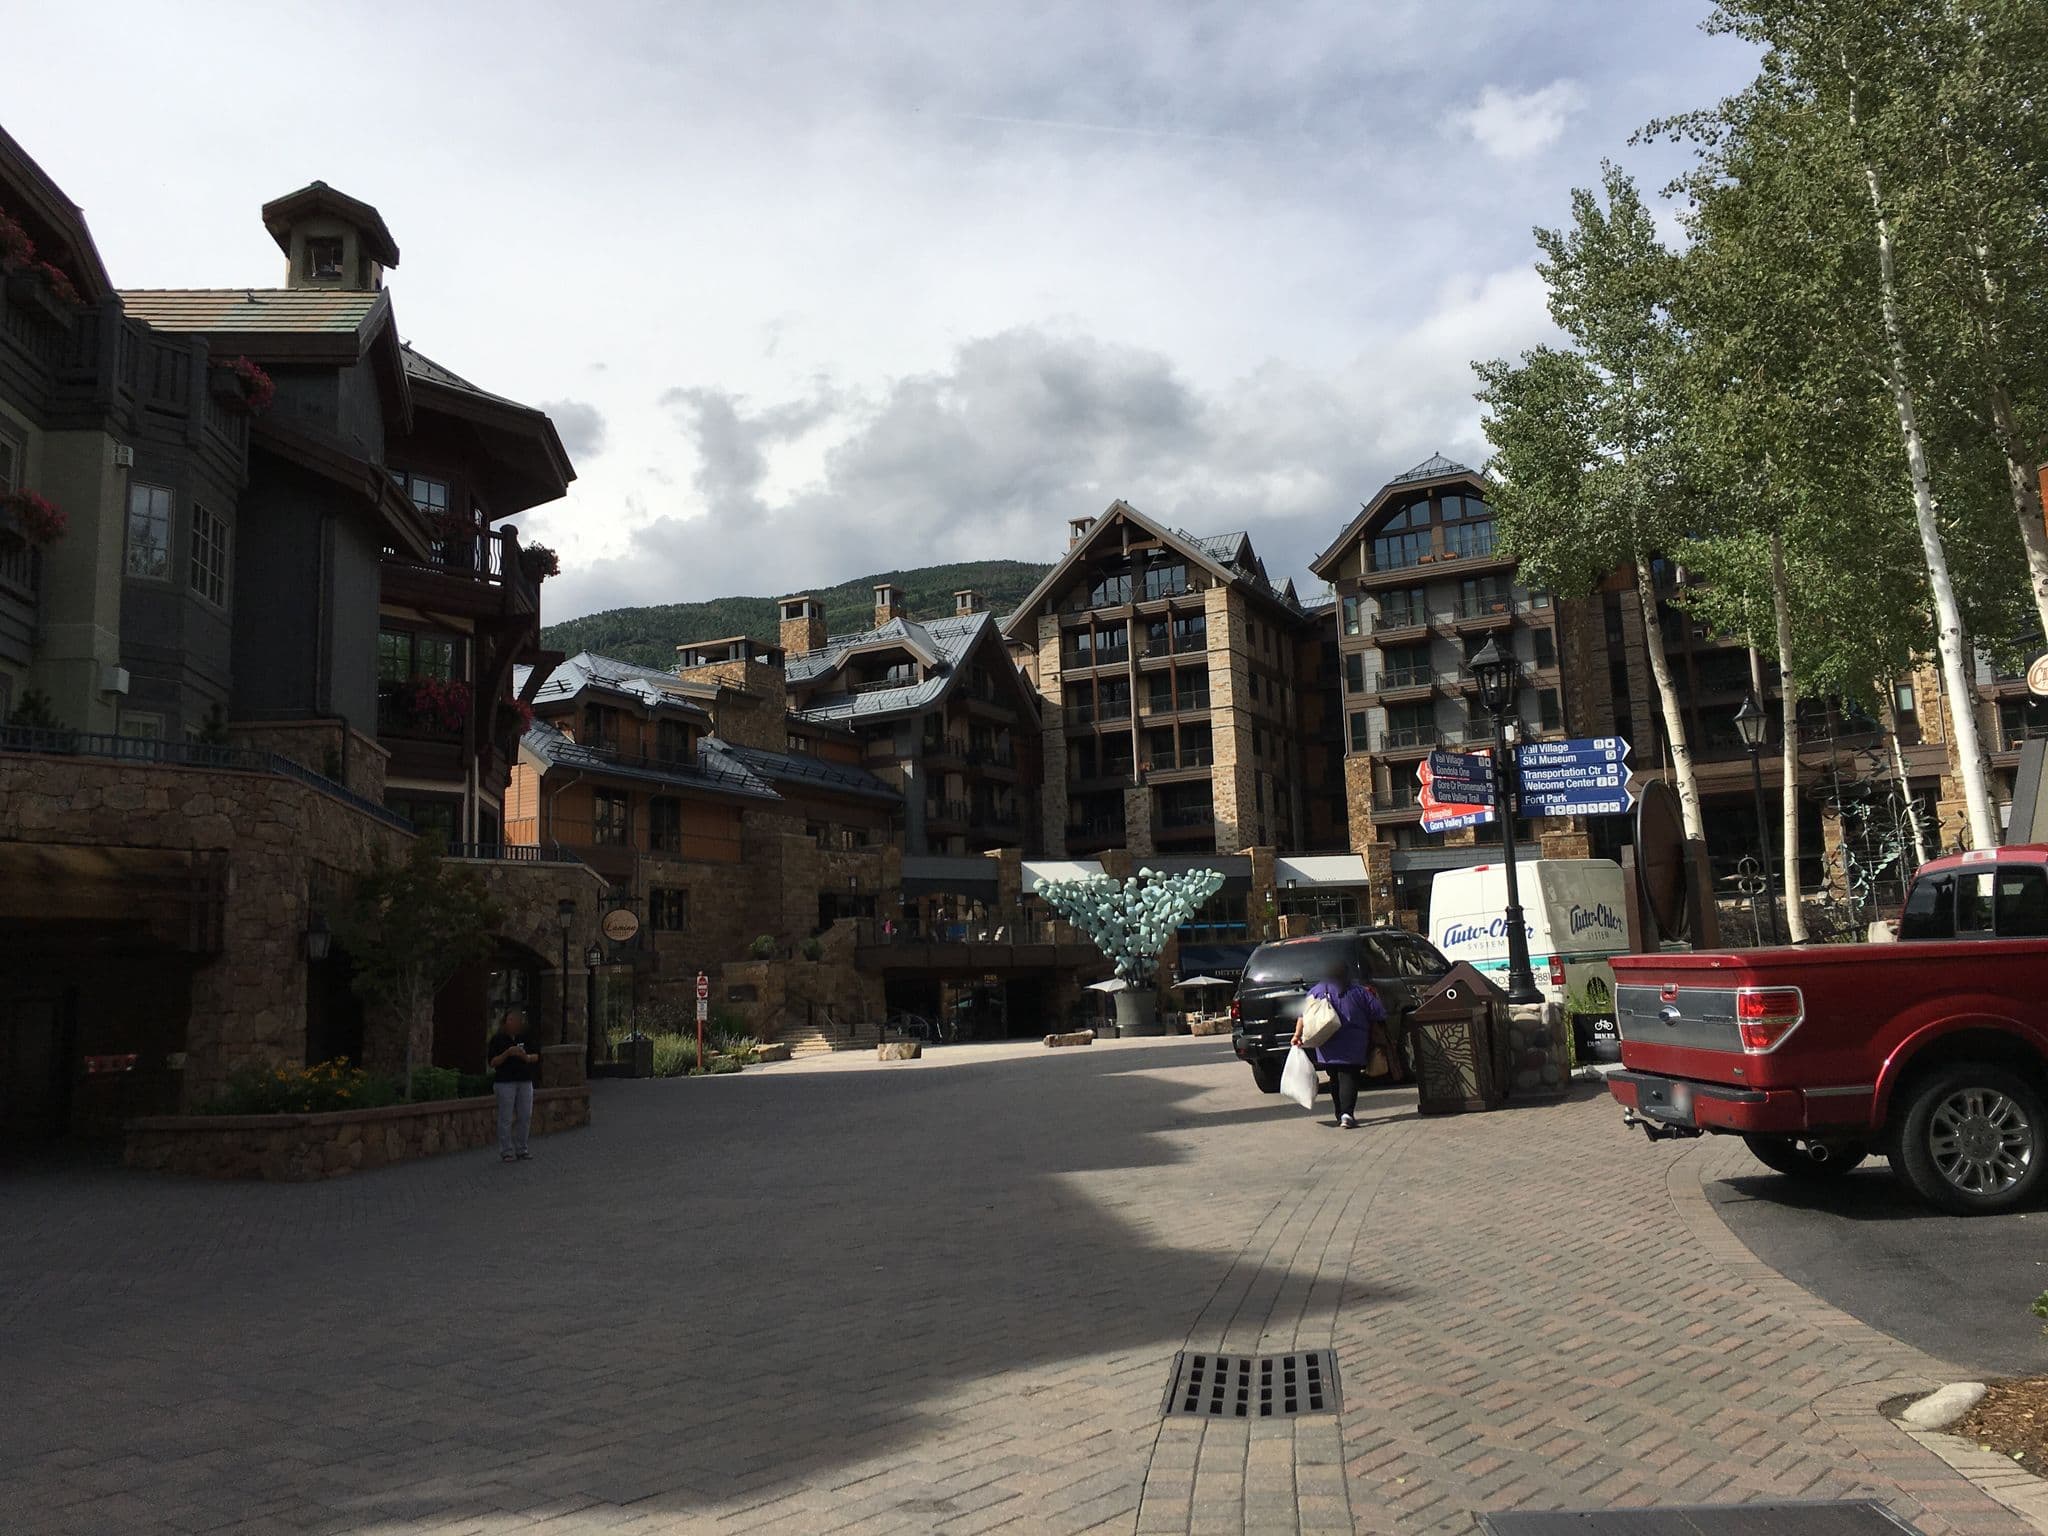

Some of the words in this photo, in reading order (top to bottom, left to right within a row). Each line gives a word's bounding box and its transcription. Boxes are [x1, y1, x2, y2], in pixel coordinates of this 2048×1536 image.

[1522, 745, 1538, 754] Vail
[1538, 743, 1569, 754] Village
[1435, 753, 1446, 764] Vail
[1446, 755, 1464, 766] Village
[1522, 756, 1537, 766] Ski
[1538, 754, 1577, 765] Museum
[1523, 767, 1586, 781] Transportation
[1588, 765, 1602, 776] Ctr
[1524, 780, 1565, 791] Welcome
[1566, 778, 1596, 788] Center
[1525, 794, 1545, 804] Ford
[1546, 793, 1568, 803] Park
[1430, 820, 1444, 831] Gore
[1444, 818, 1462, 829] Valley
[1463, 814, 1476, 824] Trail
[1467, 940, 1505, 950] SYSTEM
